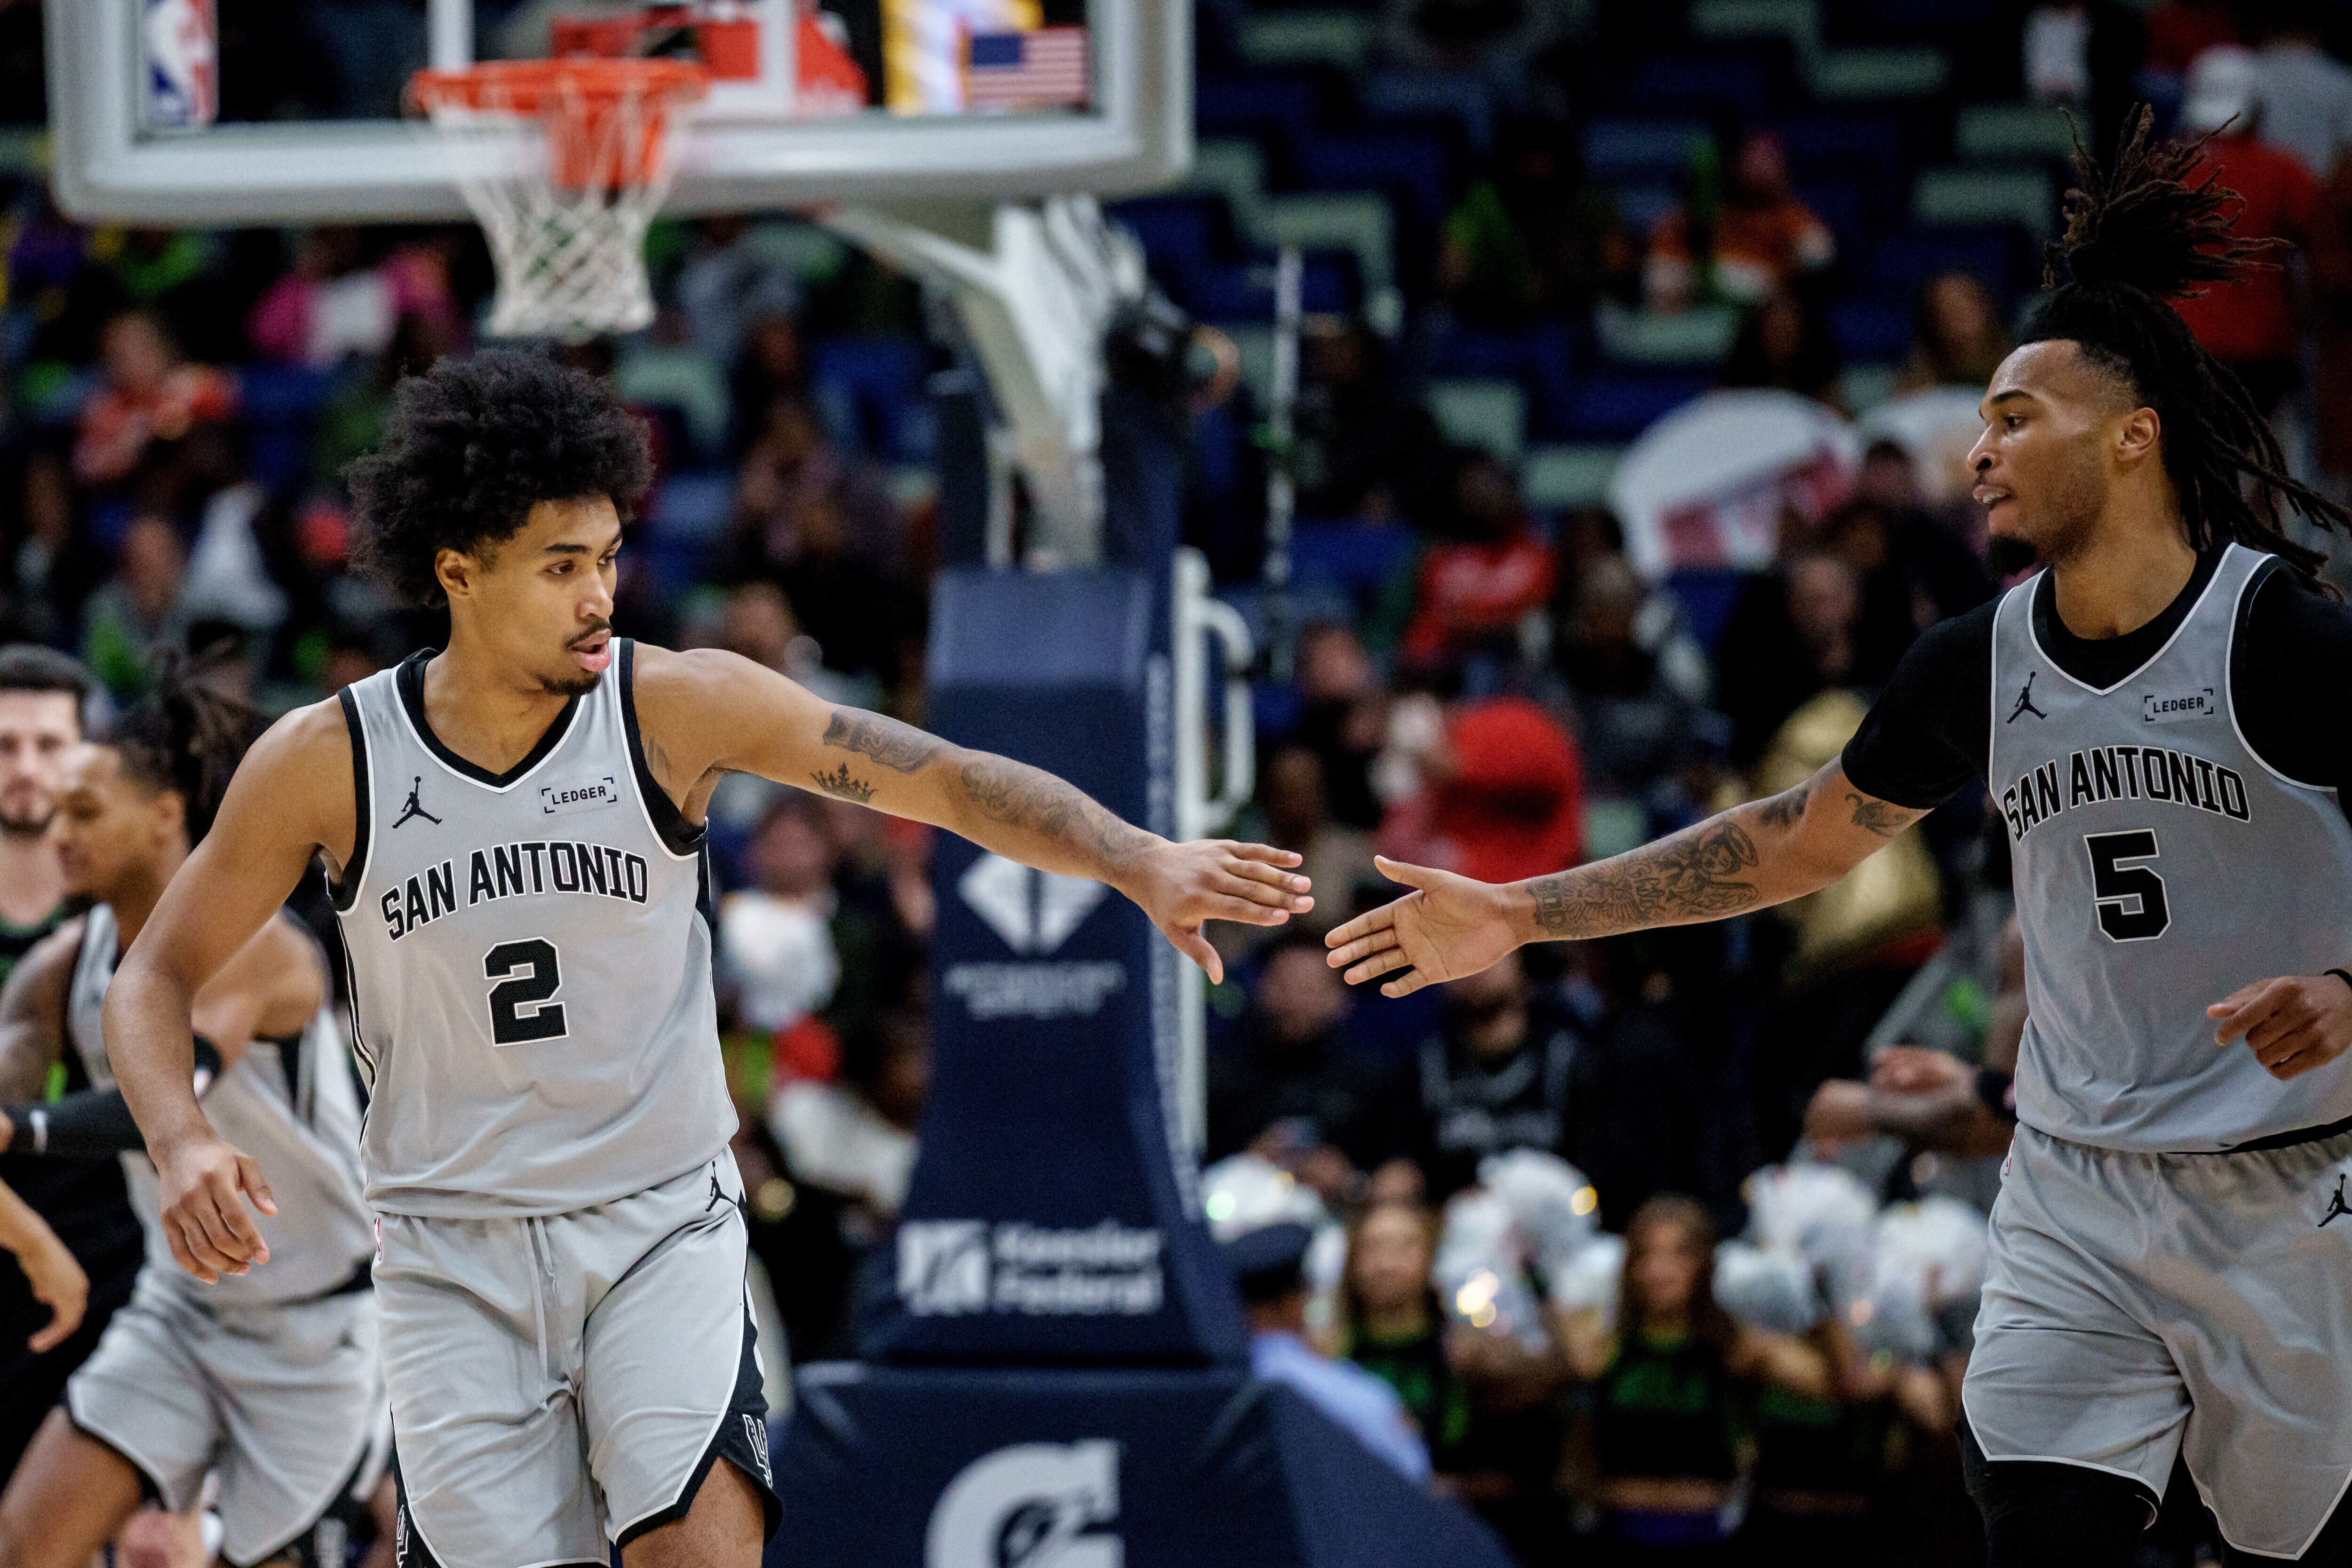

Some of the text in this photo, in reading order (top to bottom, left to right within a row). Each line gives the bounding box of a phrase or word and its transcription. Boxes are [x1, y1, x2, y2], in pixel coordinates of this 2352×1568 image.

[2153, 696, 2204, 713] LEDGER
[551, 786, 606, 805] LEDGER
[2003, 745, 2251, 843] SAN ANTONIO
[380, 840, 649, 941] SAN ANTONIO
[2083, 828, 2171, 942] 5
[482, 936, 569, 1047] 2
